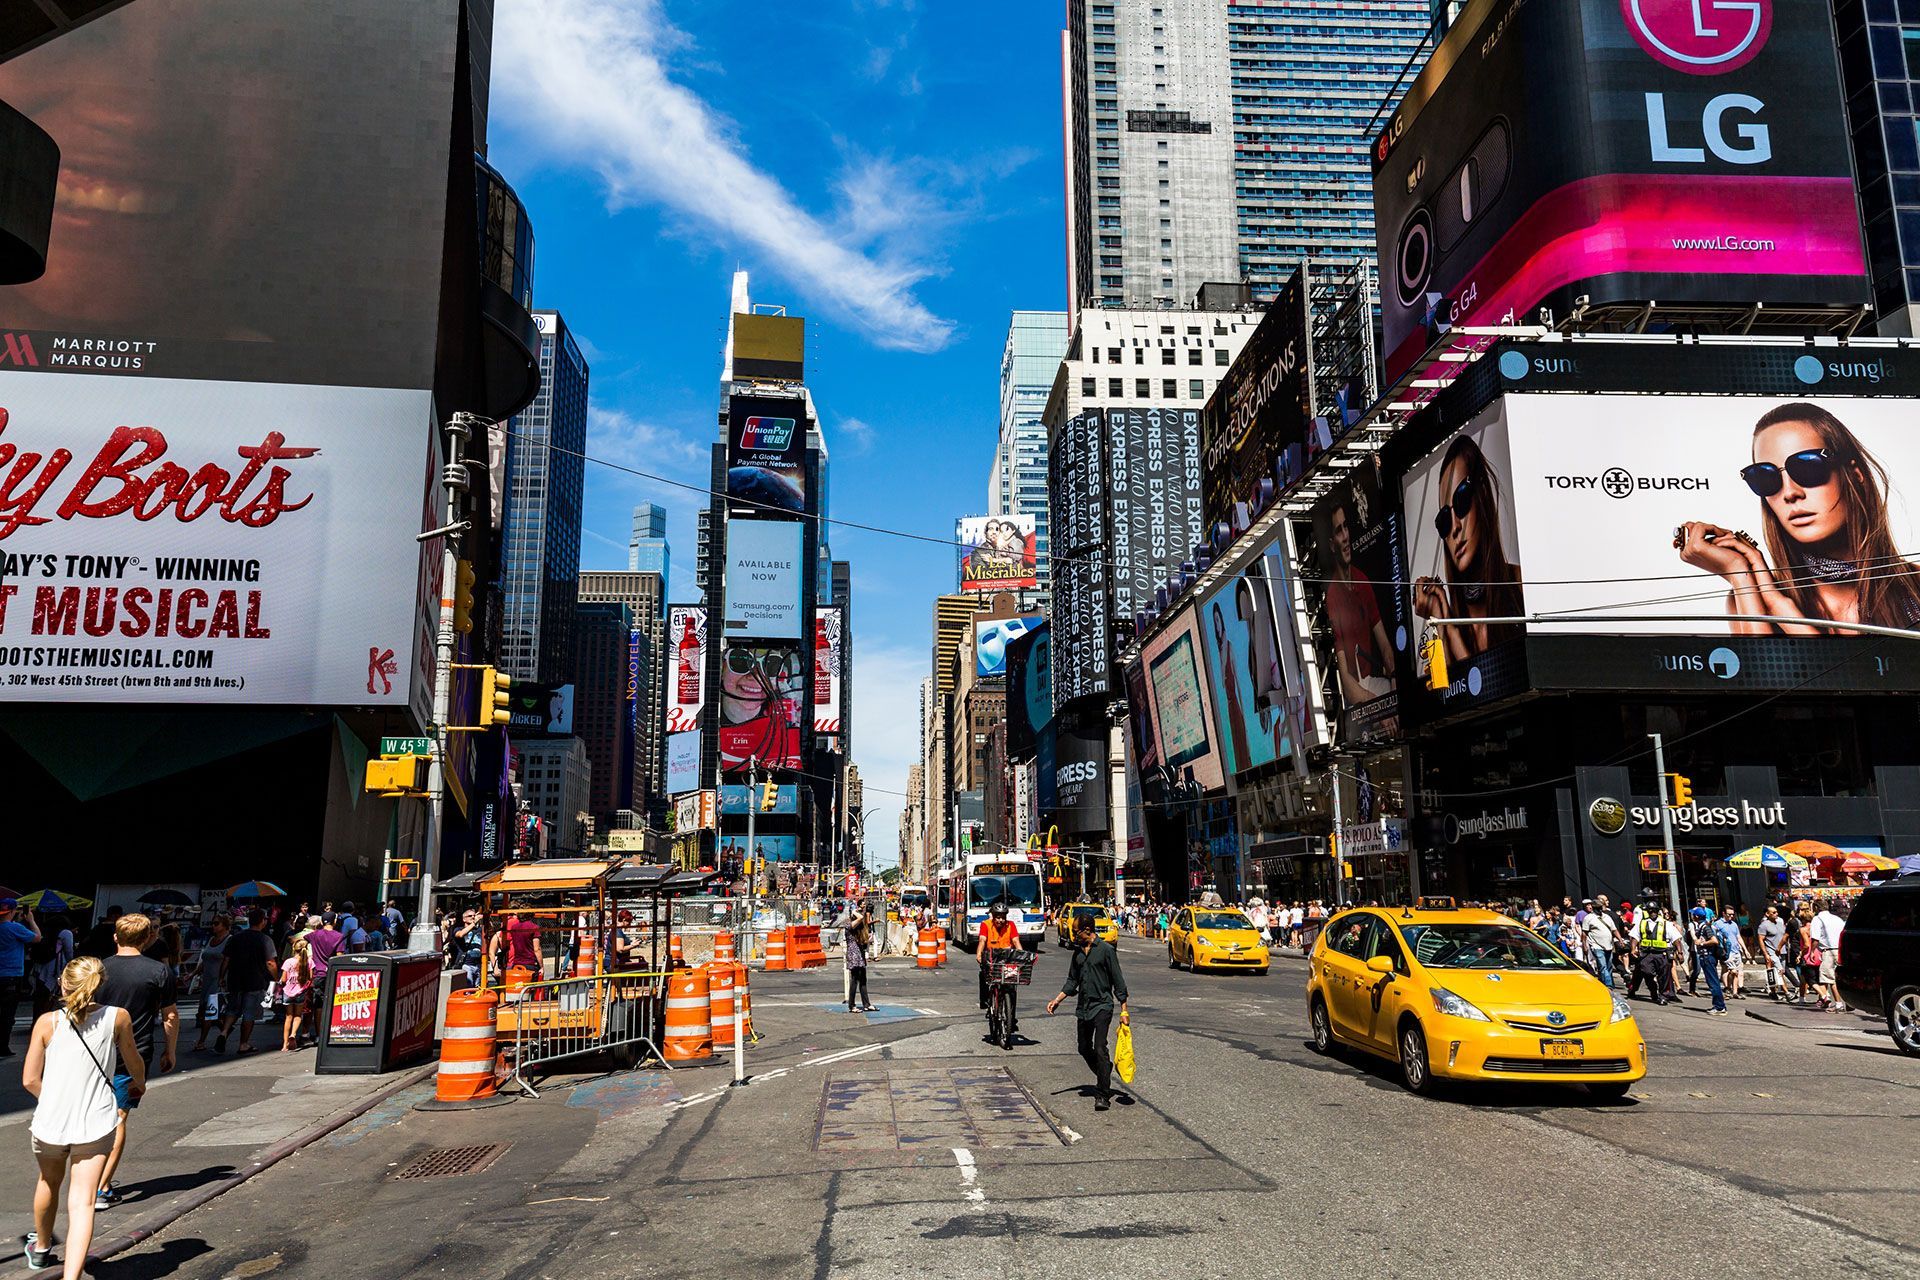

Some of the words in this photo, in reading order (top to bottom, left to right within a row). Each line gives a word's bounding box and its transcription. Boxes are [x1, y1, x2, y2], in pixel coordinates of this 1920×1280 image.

[1389, 114, 1403, 147] LG
[1645, 92, 1772, 164] LG
[1671, 236, 1774, 252] www.LG.com
[1460, 281, 1478, 311] G4
[53, 337, 157, 353] MARRIOTT
[51, 353, 142, 369] MARQUIS
[1207, 427, 1237, 472] OFFICE
[1236, 339, 1296, 434] LOCATIONS
[747, 424, 790, 440] UnionPay
[1129, 408, 1144, 450] NOW
[758, 453, 782, 461] Global
[1086, 416, 1100, 497] EXPRESS
[1111, 413, 1127, 492] EXPRESS
[1165, 427, 1181, 468] NOW
[1183, 412, 1200, 490] EXPRESS
[56, 425, 321, 527] Boots
[737, 459, 767, 467] Payment
[769, 460, 798, 468] Network
[1075, 447, 1087, 484] NOW
[1130, 453, 1146, 497] OPEN
[1167, 471, 1183, 516] OPEN
[1544, 476, 1598, 489] TORY
[1637, 477, 1710, 490] BURCH
[1067, 470, 1078, 549] EXPRESS
[1077, 491, 1088, 533] OPEN
[1132, 499, 1147, 541] NOW
[1149, 479, 1166, 559] EXPRESS
[1114, 499, 1130, 580] EXPRESS
[1169, 518, 1184, 560] NOW
[1387, 511, 1398, 544] hut
[155, 557, 261, 582] WINNING
[738, 560, 791, 569] AVAILABLE
[751, 573, 777, 581] NOW
[965, 563, 1034, 580] Misérables
[989, 556, 1007, 568] Les
[1133, 544, 1150, 590] OPEN
[31, 585, 271, 639] MUSICAL
[732, 602, 795, 612] Samsung.com/
[744, 611, 783, 620] Decisions
[1091, 590, 1105, 674] EXPRESS
[8, 674, 28, 686] 302
[30, 675, 57, 687] West
[58, 675, 83, 687] 45th
[85, 675, 119, 687] Street
[121, 675, 151, 689] (btwn
[153, 676, 171, 687] 8th
[173, 676, 191, 687] and
[194, 676, 211, 688] 9th
[213, 676, 244, 690] Aves.)
[626, 637, 640, 700] NOVOTEL
[386, 740, 397, 752] W
[400, 740, 414, 752] 45
[417, 739, 424, 747] St
[733, 737, 748, 745] Erin
[485, 803, 493, 830] EAGLE
[1458, 810, 1505, 840] sunglass
[1504, 806, 1529, 830] hut
[1741, 799, 1787, 825] hut
[1352, 827, 1371, 843] POLO
[1010, 864, 1019, 872] ST
[336, 972, 380, 994] JERSEY
[341, 1000, 371, 1021] BOYS
[1552, 1045, 1568, 1056] 8C40
